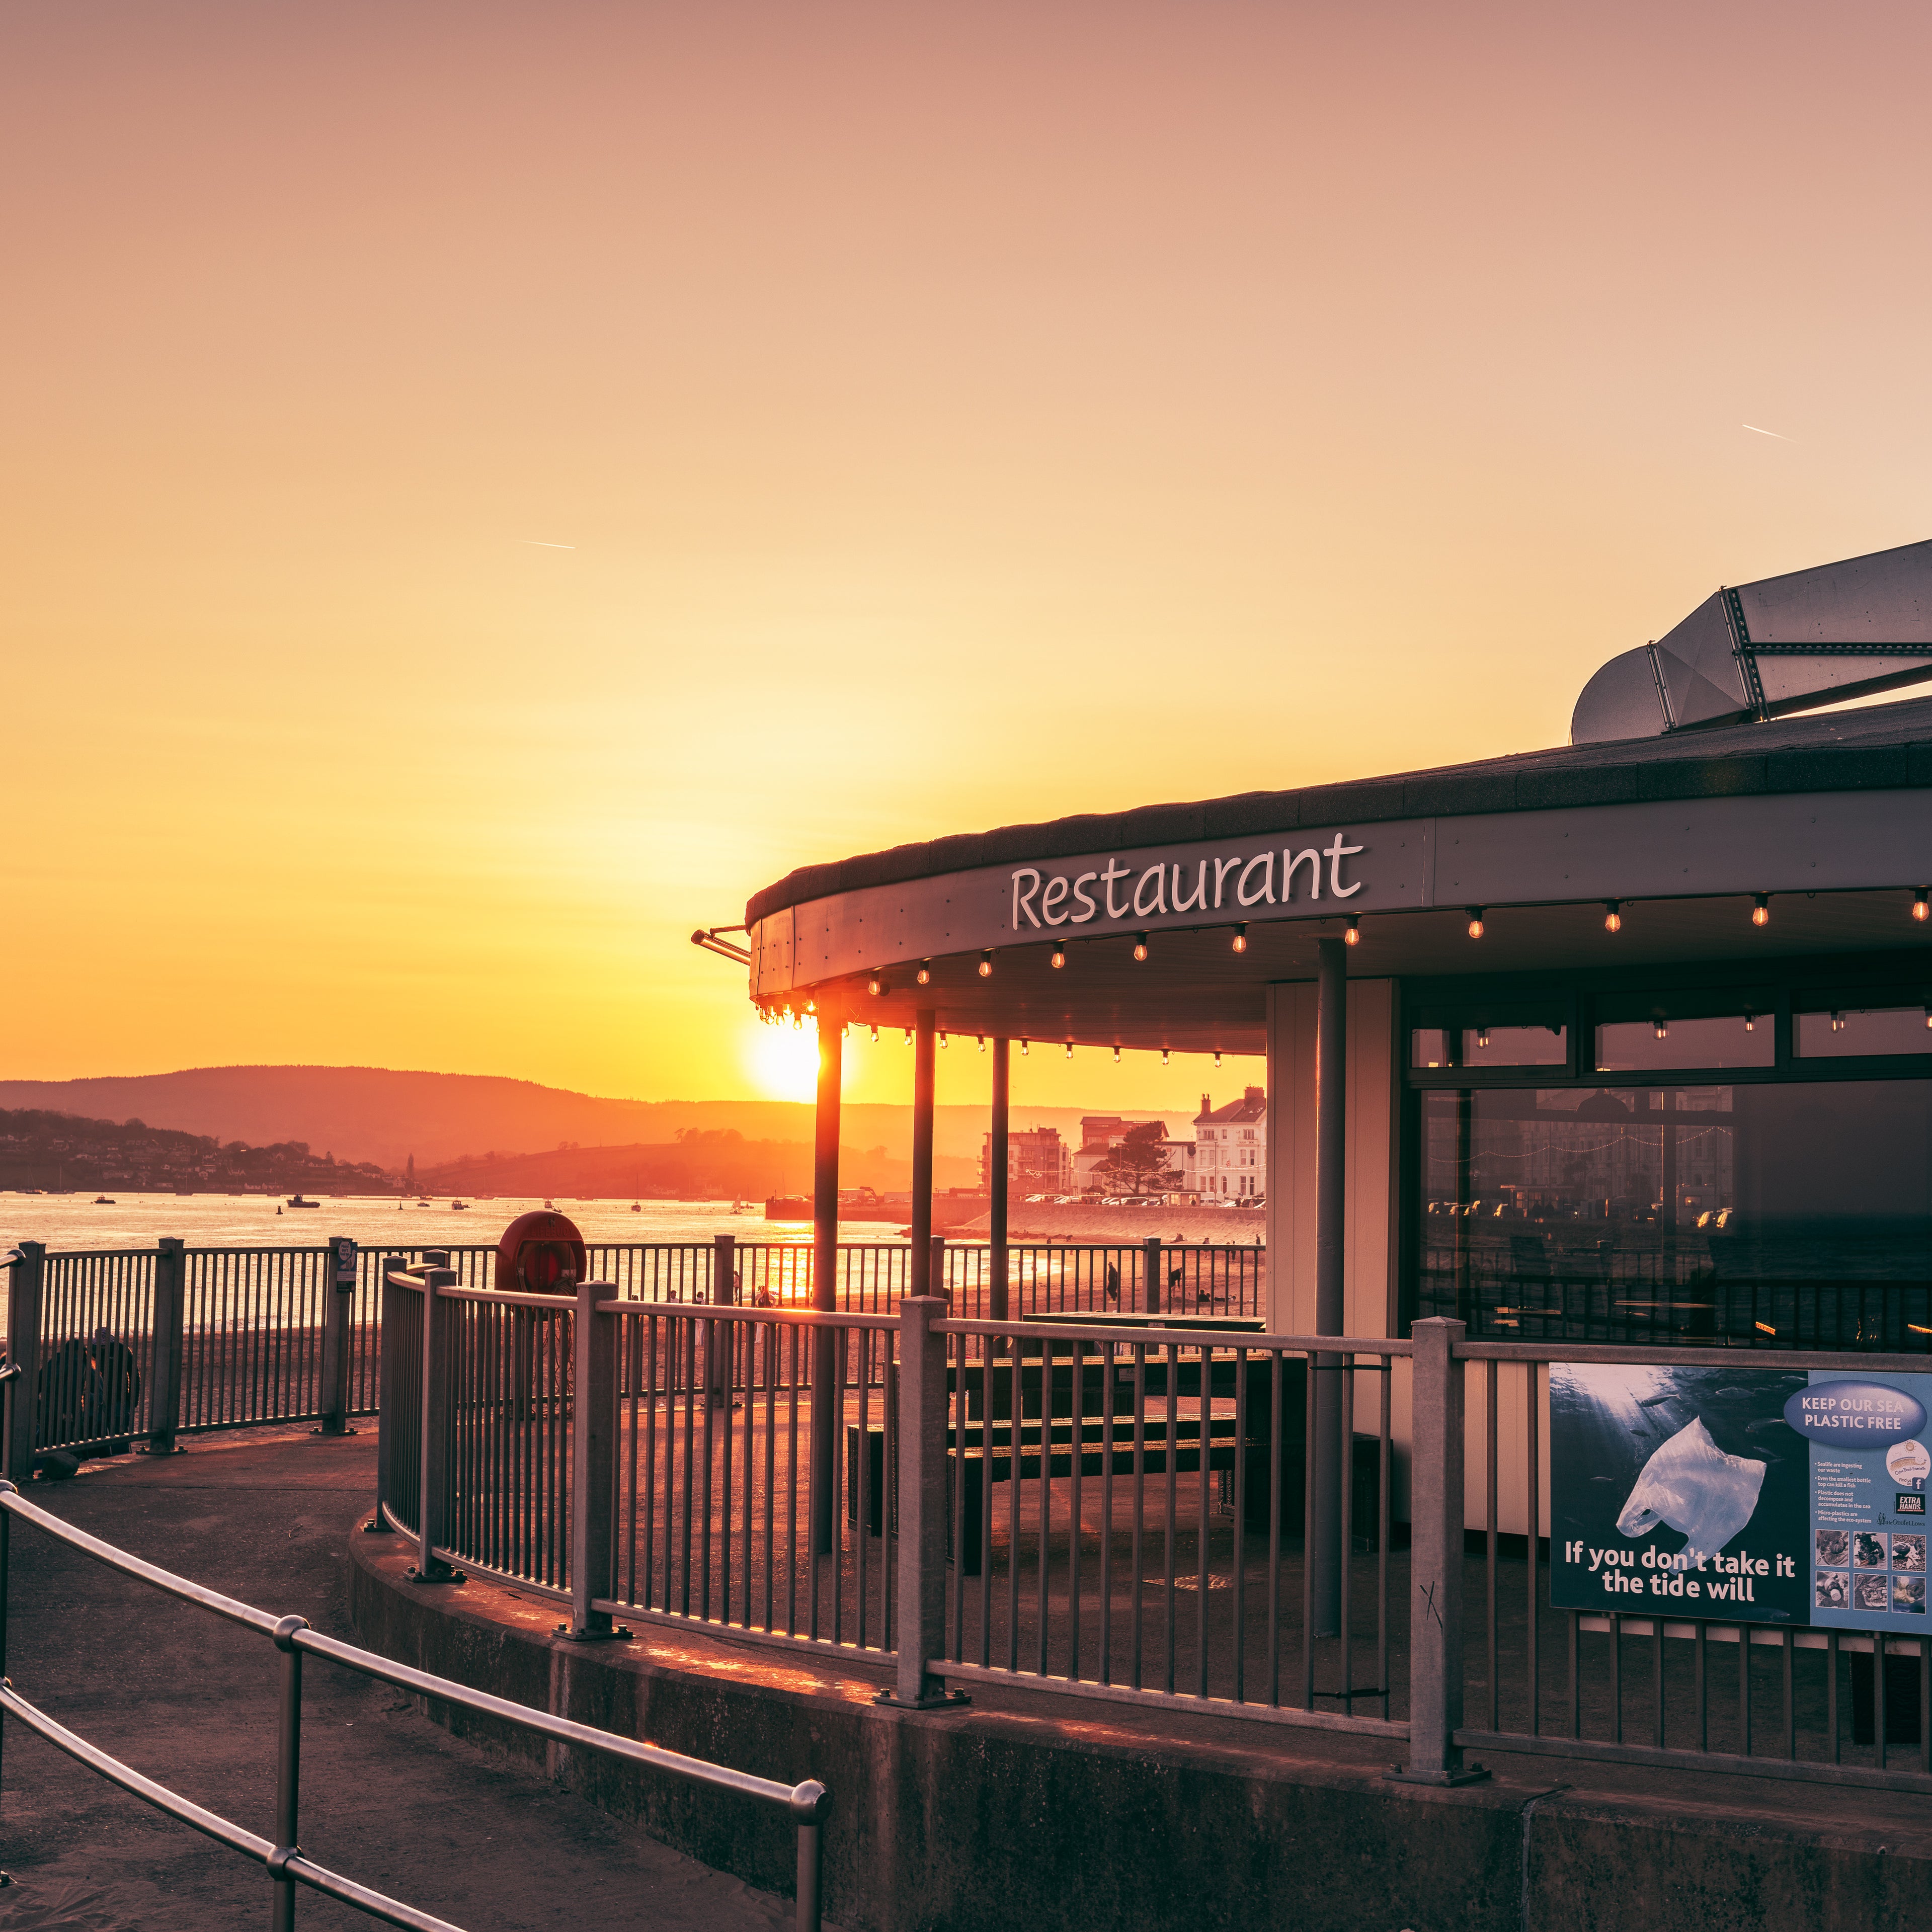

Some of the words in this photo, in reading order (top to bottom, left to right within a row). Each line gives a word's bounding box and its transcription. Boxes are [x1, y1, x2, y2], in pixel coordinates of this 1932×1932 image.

[1011, 833, 1363, 930] Restaurant
[530, 1227, 573, 1237] LIFEBUOY
[1802, 1398, 1836, 1410] KEEP
[1840, 1399, 1873, 1411] OUR
[1877, 1400, 1904, 1413] SEA
[1805, 1414, 1864, 1428] PLASTIC
[1868, 1417, 1901, 1430] FREE
[1566, 1541, 1583, 1563] If
[1588, 1548, 1634, 1571] you
[1641, 1545, 1707, 1572] don't
[1713, 1551, 1769, 1575] take
[1776, 1553, 1795, 1577] it
[1602, 1569, 1643, 1593] the
[1650, 1572, 1700, 1597] tide
[1707, 1577, 1754, 1601] will
